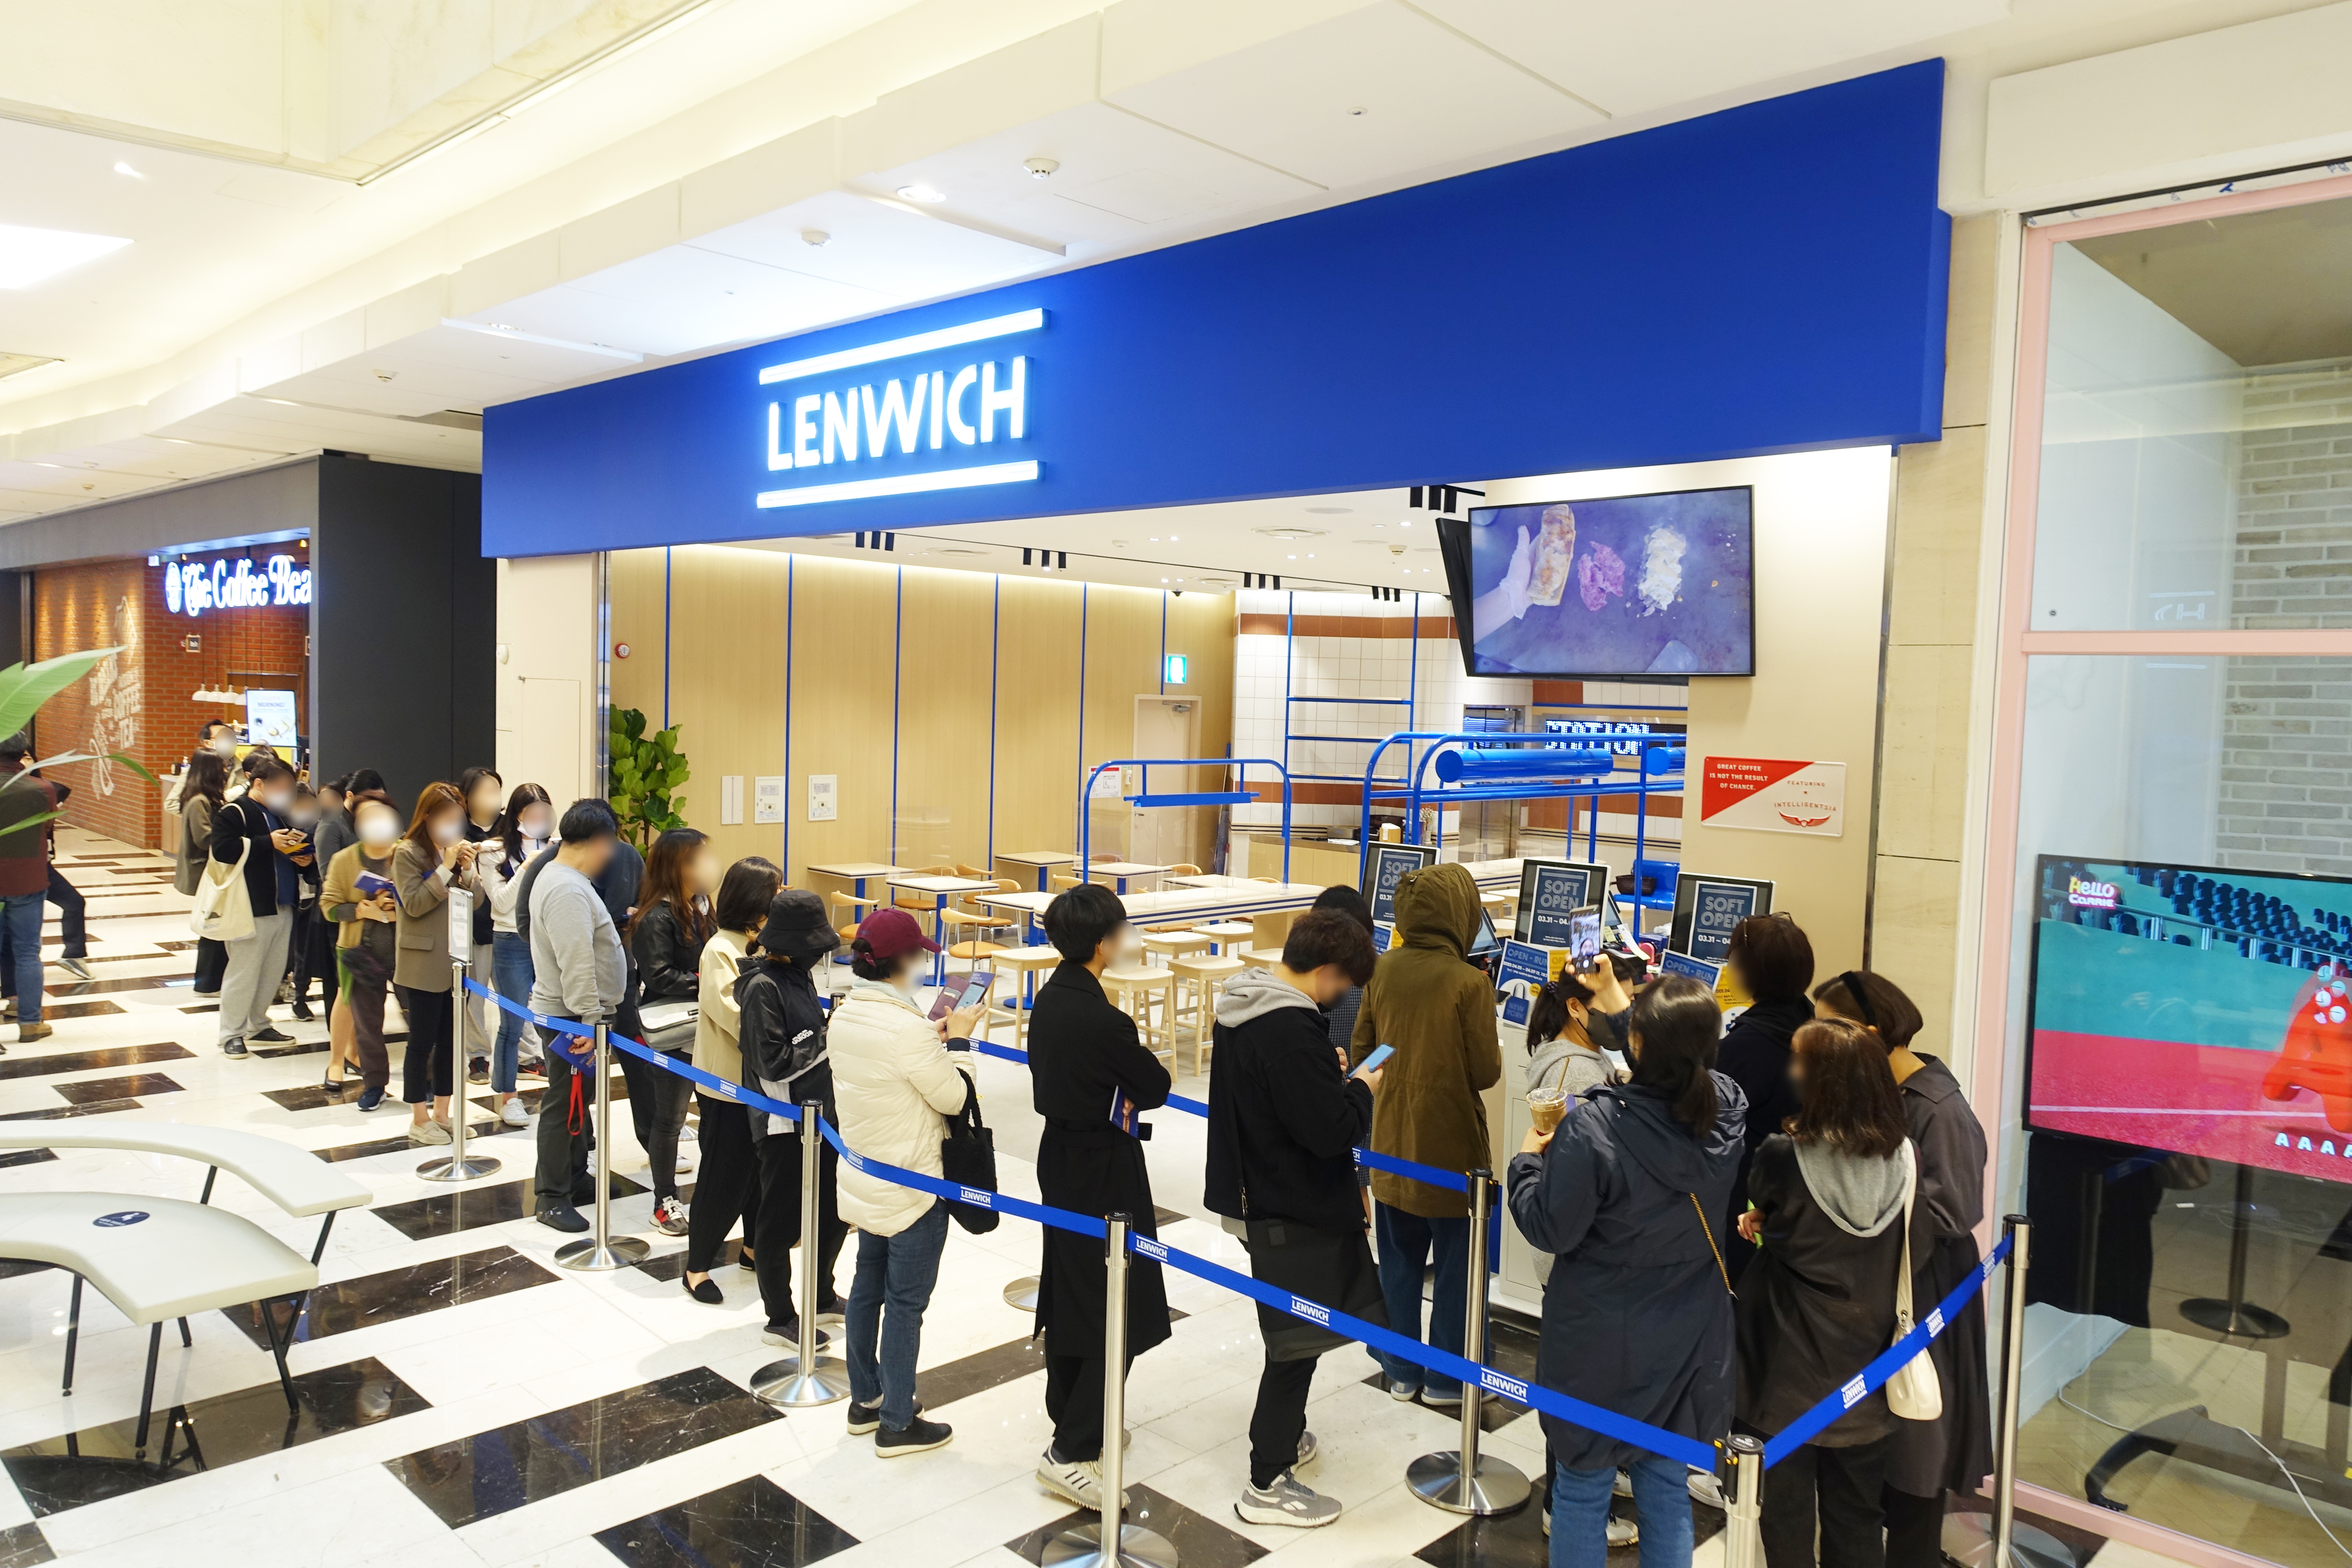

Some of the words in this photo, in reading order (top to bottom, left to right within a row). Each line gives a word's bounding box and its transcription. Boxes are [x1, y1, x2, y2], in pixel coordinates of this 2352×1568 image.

[768, 356, 1027, 471] LENWICH
[182, 563, 212, 617] The
[212, 558, 269, 608] Coffee
[1774, 801, 1837, 812] INTELLIGENTSIA
[1385, 861, 1415, 873] SOFT
[1544, 879, 1580, 896] SOFT
[1540, 893, 1579, 910] OPEN
[1705, 896, 1745, 913] SOFT
[1537, 915, 1553, 924] 03.31
[1559, 917, 1569, 926] 04.
[1698, 934, 1715, 943] 03.31
[1507, 948, 1529, 961] OPEN
[1666, 960, 1690, 974] OPEN
[1695, 969, 1714, 982] RUN
[1509, 1002, 1524, 1012] NEW
[792, 1029, 814, 1045] adidas
[961, 1189, 991, 1204] LENWICH
[1136, 1239, 1167, 1259] LENWICH
[1292, 1299, 1329, 1322] LENWICH
[1481, 1371, 1527, 1399] LENWICH
